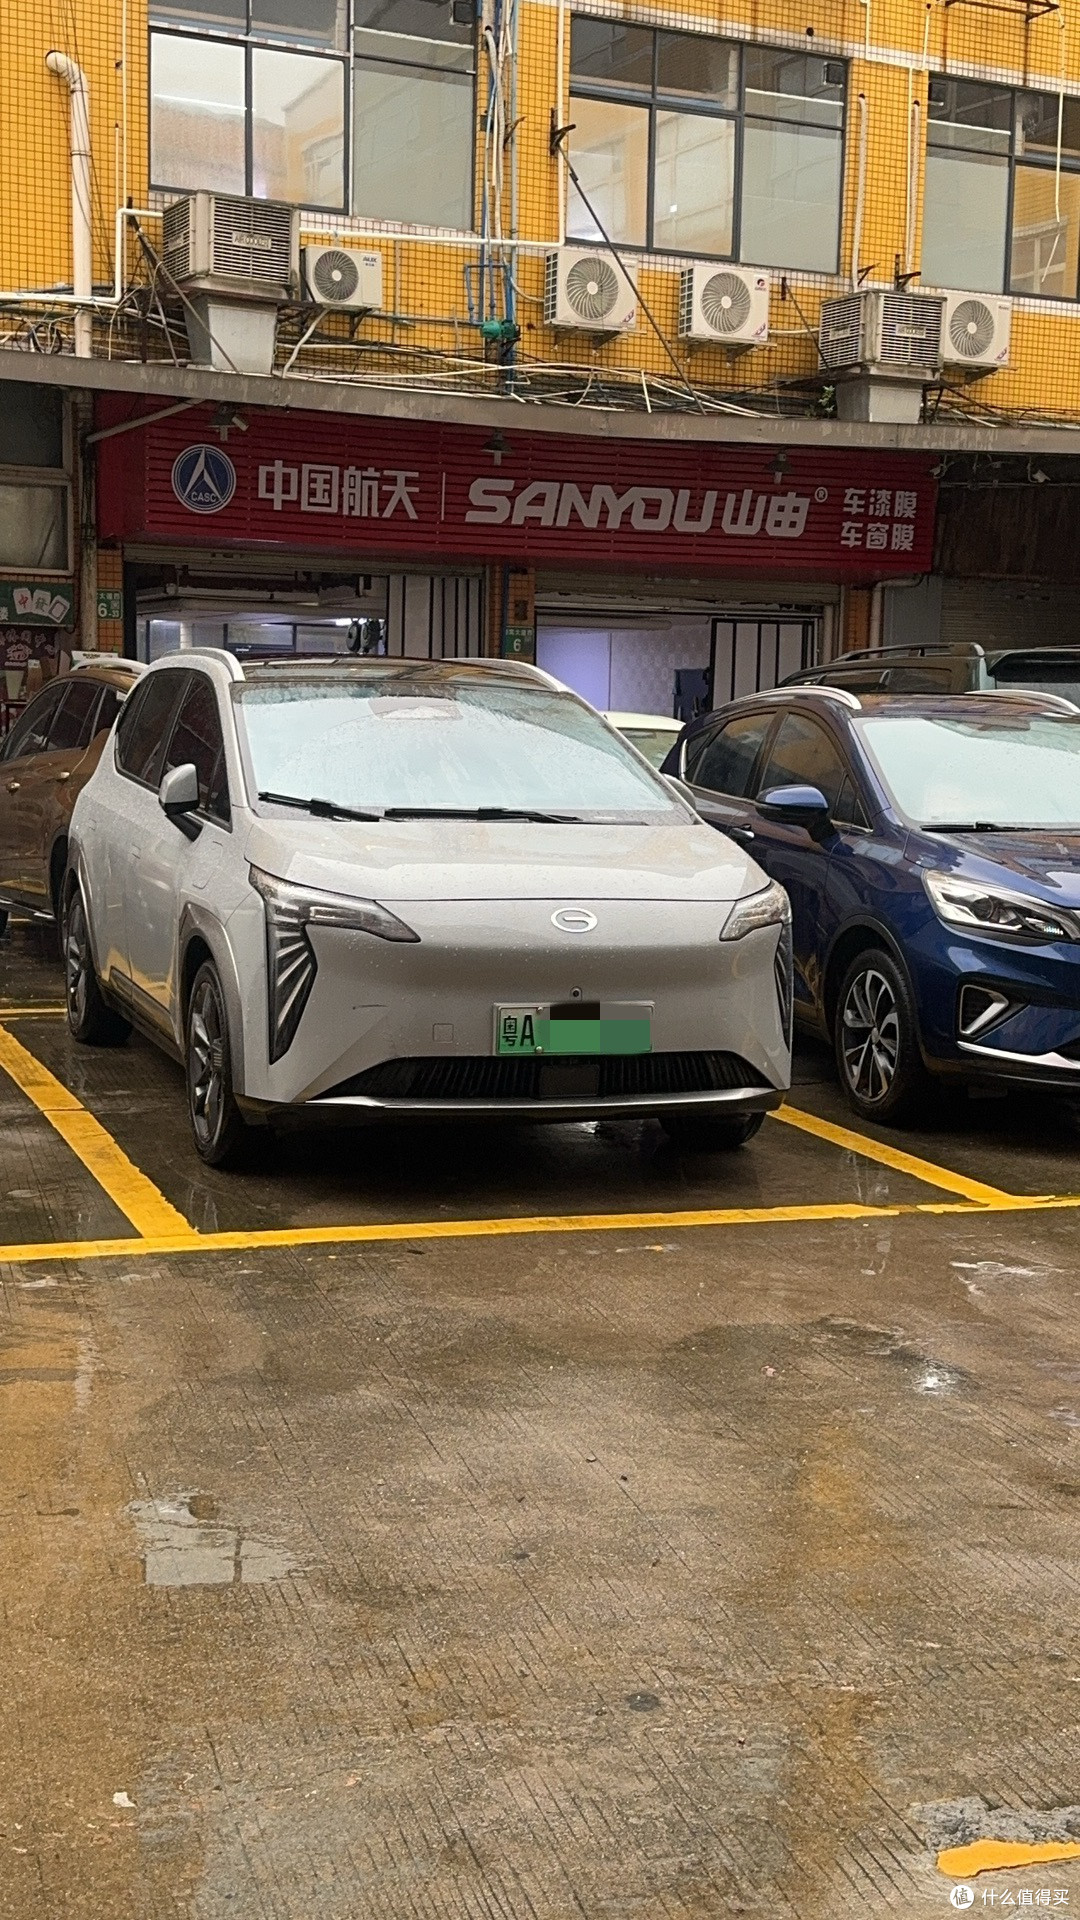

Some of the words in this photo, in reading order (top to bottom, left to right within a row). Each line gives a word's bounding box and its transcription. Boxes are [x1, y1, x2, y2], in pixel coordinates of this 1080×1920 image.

[191, 491, 218, 503] CASC
[257, 459, 420, 520] 中国航天
[842, 487, 918, 519] 车漆膜
[465, 477, 716, 534] SANYOU
[720, 488, 810, 537] 山由
[840, 521, 915, 551] 车窗膜
[513, 638, 522, 652] 6
